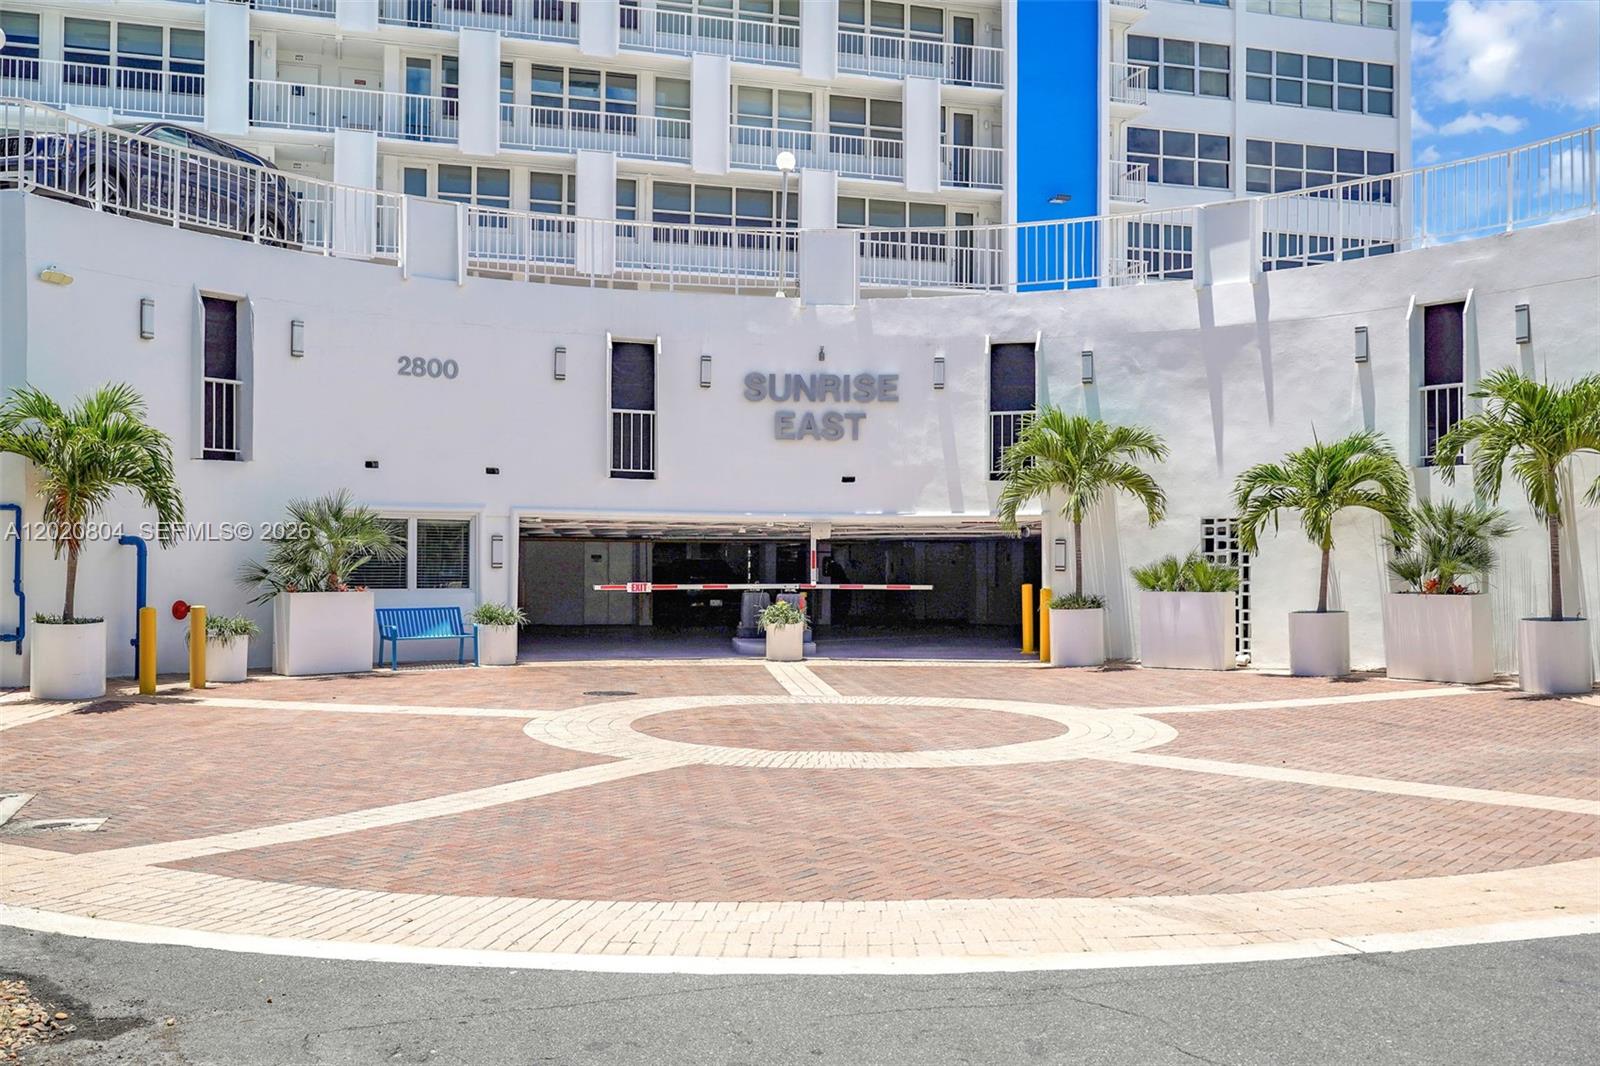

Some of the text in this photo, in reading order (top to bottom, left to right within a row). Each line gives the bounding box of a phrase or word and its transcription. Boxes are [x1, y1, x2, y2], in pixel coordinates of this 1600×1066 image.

[397, 355, 459, 379] 2800
[743, 372, 899, 403] SUNRISE
[774, 410, 867, 441] EAST
[631, 583, 648, 592] EXIT
